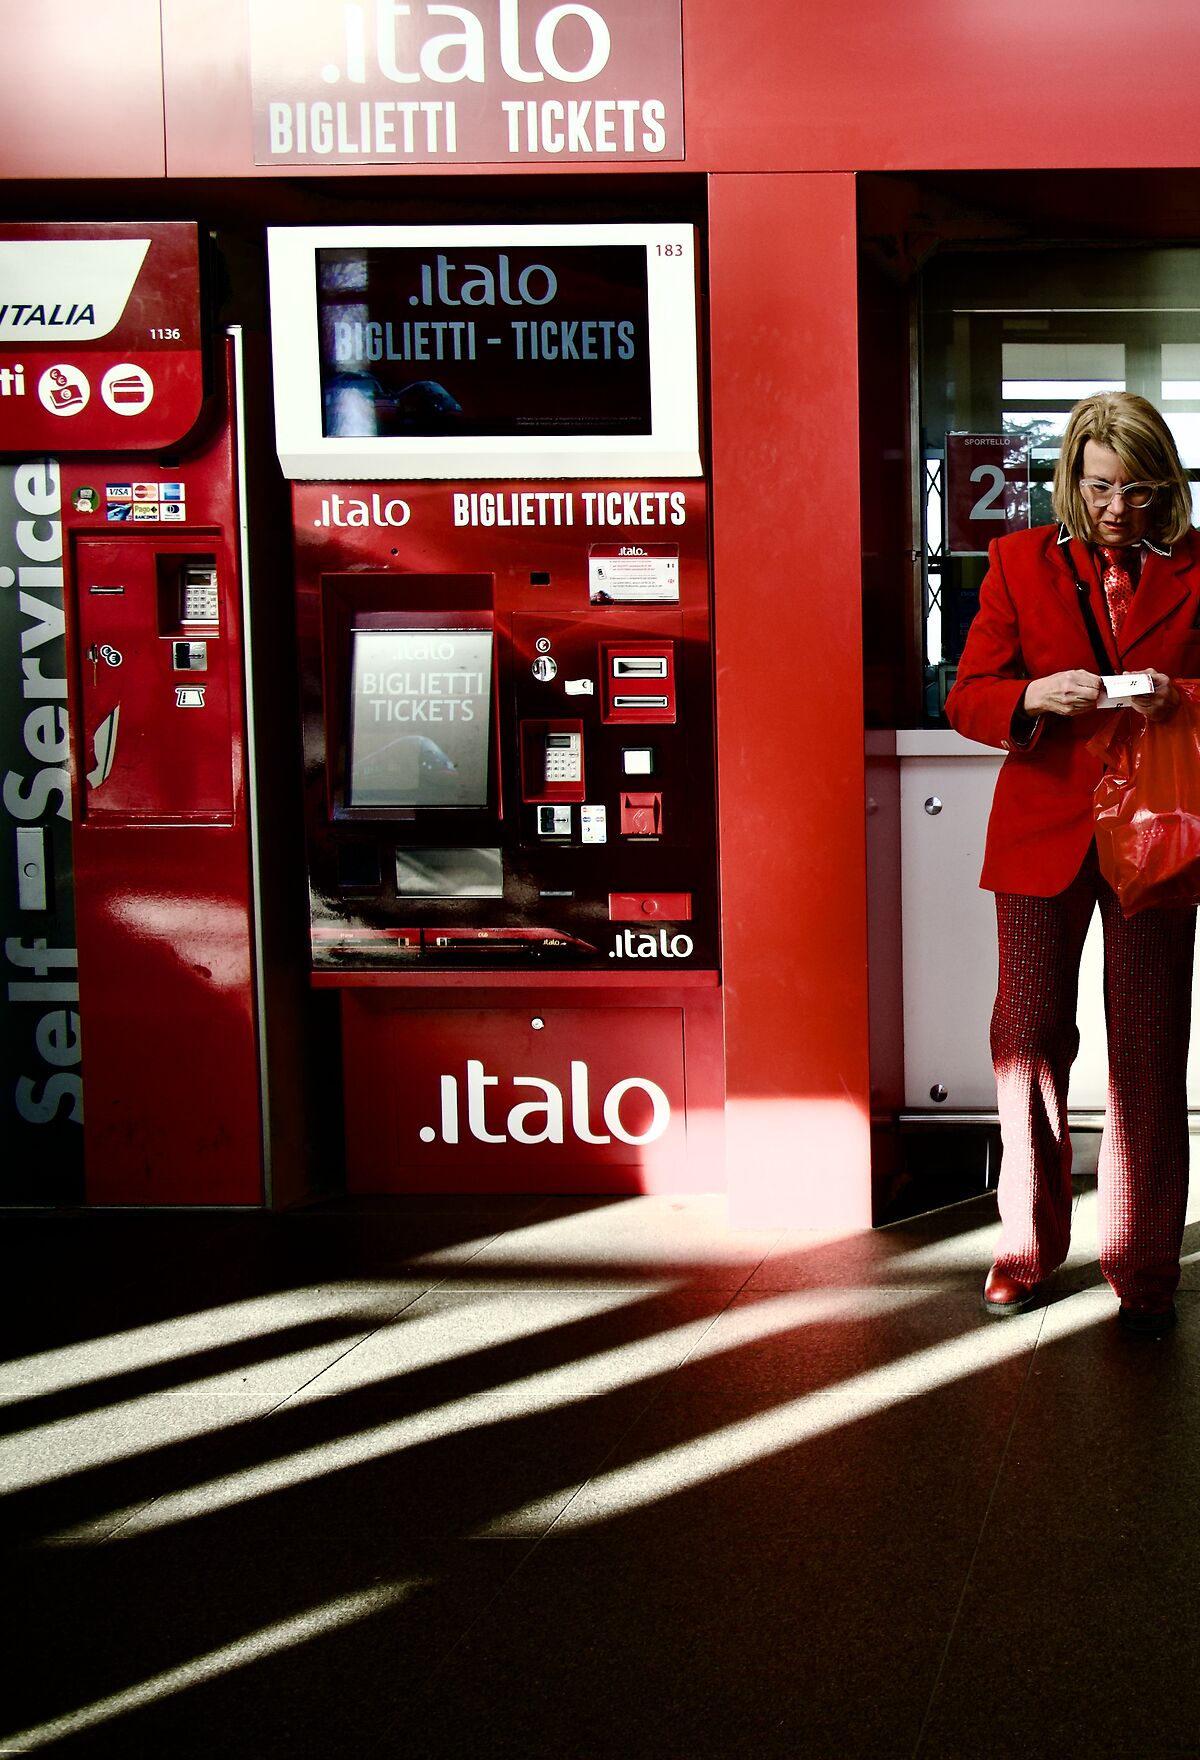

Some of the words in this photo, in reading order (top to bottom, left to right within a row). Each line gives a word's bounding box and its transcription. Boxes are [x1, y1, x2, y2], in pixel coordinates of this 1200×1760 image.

[270, 101, 456, 154] BIGLIETTI
[502, 99, 667, 153] TICKETS
[655, 244, 684, 257] 183
[0, 304, 95, 326] ITALIA
[150, 328, 181, 340] 1136
[334, 322, 477, 360] BIGLIETTI
[512, 321, 635, 359] TICKETS
[964, 438, 1011, 446] SPORTELLO
[109, 488, 129, 496] VISA
[969, 465, 1006, 520] 2
[454, 492, 574, 527] BIGLIETTI
[581, 491, 686, 526] TICKETS
[0, 456, 72, 821] Service
[362, 672, 483, 695] BIGLIETTI
[369, 700, 474, 722] TICKETS
[5, 935, 85, 1127] Self
